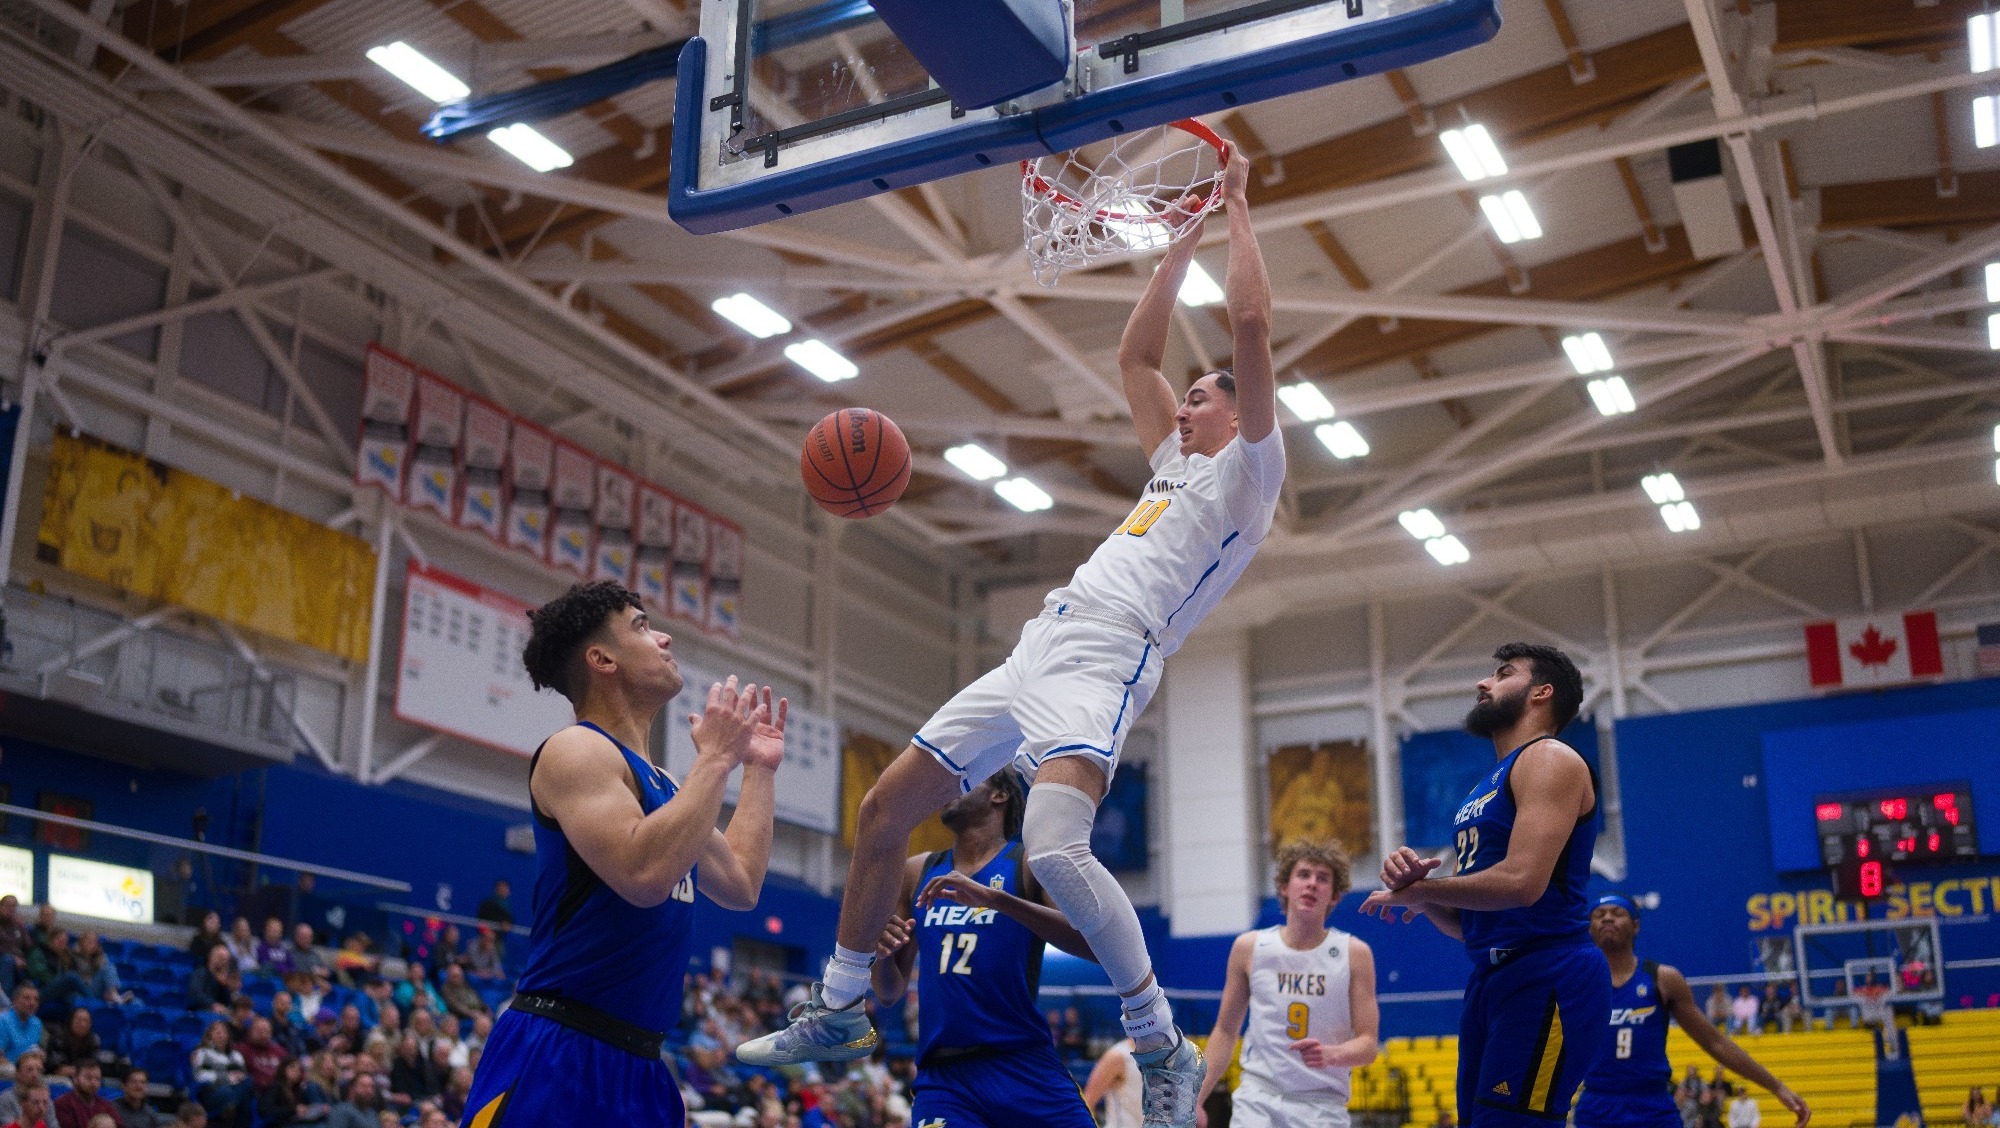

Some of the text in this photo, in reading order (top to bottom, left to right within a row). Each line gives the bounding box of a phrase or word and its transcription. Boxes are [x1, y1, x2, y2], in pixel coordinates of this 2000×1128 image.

[1113, 498, 1172, 538] 10
[1453, 786, 1500, 827] HEAT
[1457, 826, 1479, 873] 22
[1860, 860, 1883, 897] 8
[923, 906, 999, 928] HEAT
[939, 932, 978, 975] 12
[1277, 973, 1326, 996] VIKES
[1286, 1001, 1310, 1040] 9
[1609, 1005, 1657, 1026] EAT
[1616, 1027, 1633, 1060] 9
